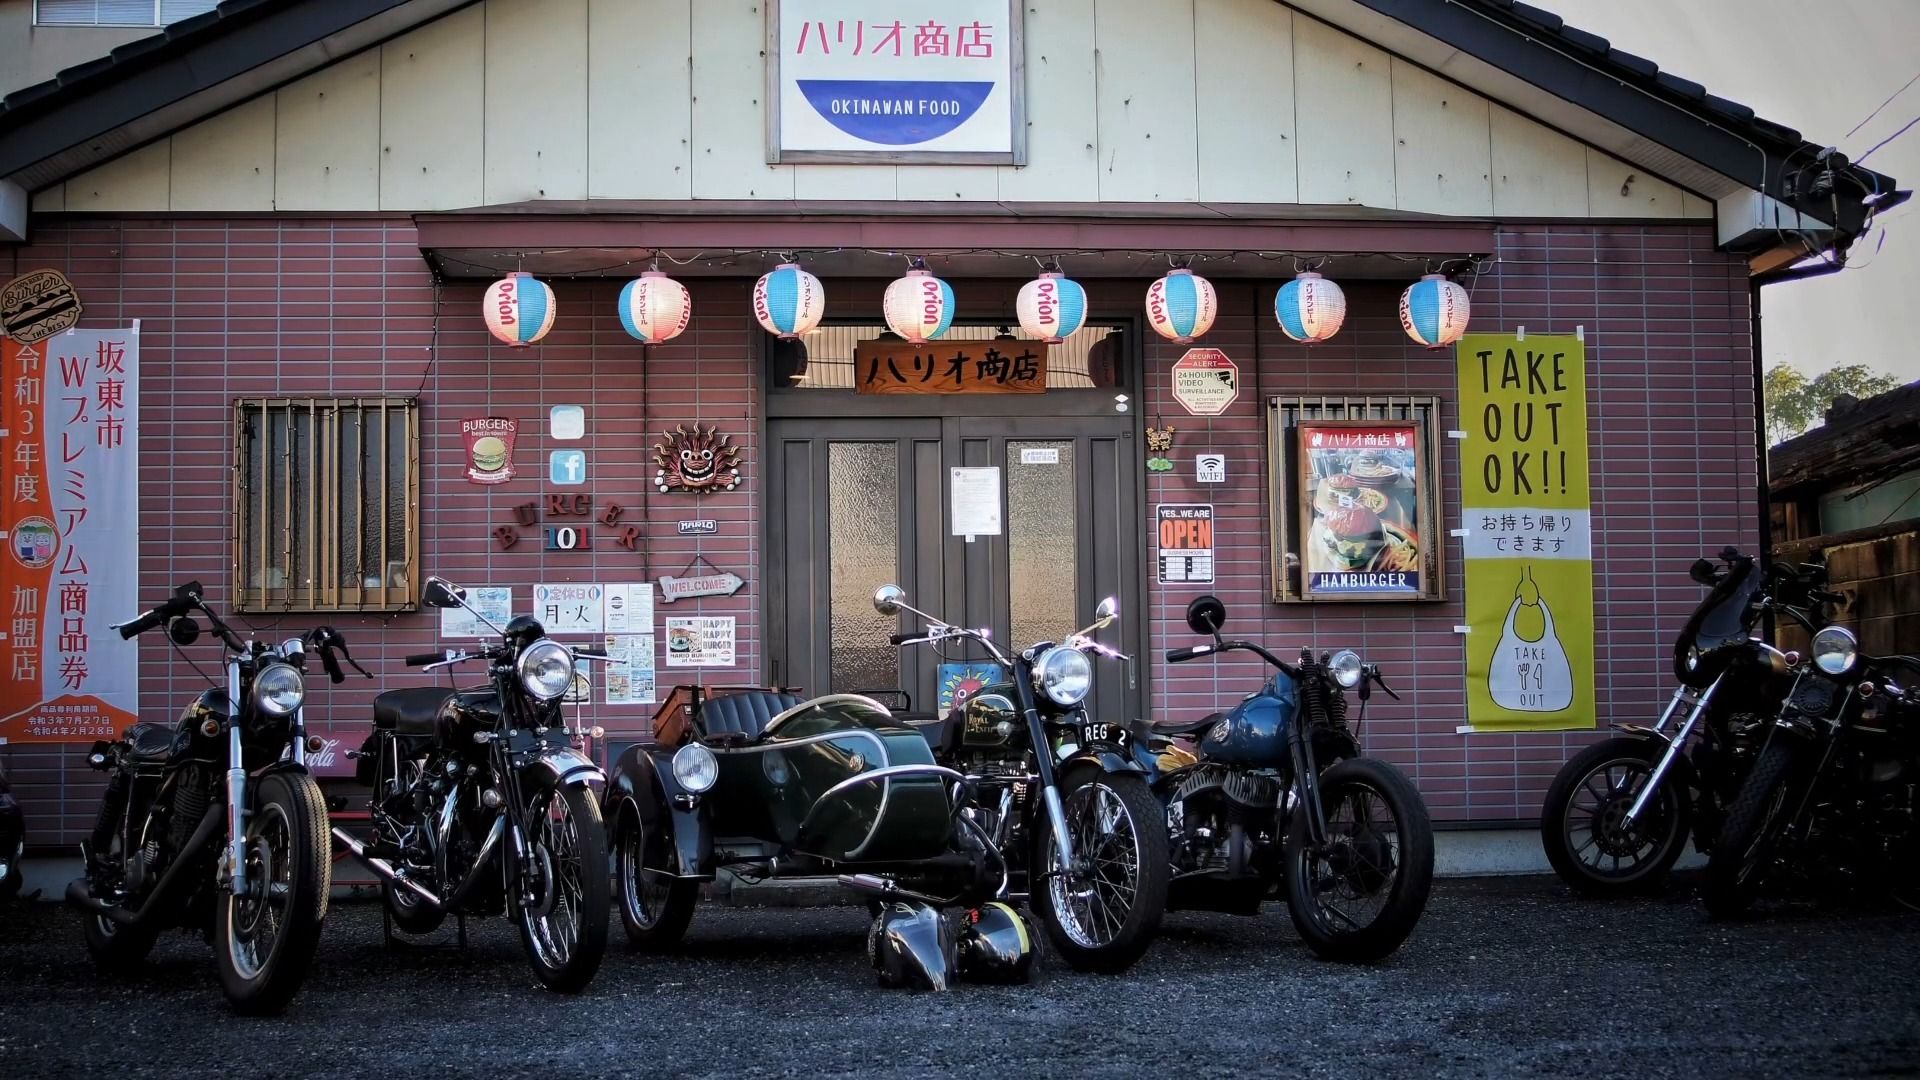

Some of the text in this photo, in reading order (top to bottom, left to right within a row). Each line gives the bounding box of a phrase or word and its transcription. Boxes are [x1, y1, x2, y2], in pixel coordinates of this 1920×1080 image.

[796, 20, 993, 57] ハリオ商店
[831, 99, 960, 116] OKINAWAN FOOD
[5, 276, 60, 309] Burger
[866, 348, 1039, 384] ハリオ商店
[1476, 348, 1567, 395] TAKE
[1177, 371, 1213, 379] 24 HOUR
[96, 340, 126, 449] 坂東市
[463, 419, 515, 433] BURGERS
[1483, 402, 1562, 445] OUT
[1328, 434, 1390, 446] ハリオ商店
[1483, 451, 1566, 495] OK!!
[58, 356, 90, 691] Wプレミアム商品券
[493, 494, 641, 550] BURGER
[681, 521, 714, 530] MARIO
[1482, 514, 1571, 532] お持ち帰り
[545, 527, 591, 549] 101
[1160, 520, 1211, 549] OPEN
[1492, 535, 1565, 552] できます
[669, 578, 727, 593] WELCOME
[1321, 573, 1406, 588] HAMBURGER
[551, 587, 586, 600] 定休日
[703, 620, 731, 628] HAPPY
[11, 585, 38, 681] 加盟店
[703, 631, 731, 639] HAPPY
[703, 641, 731, 649] BURGER
[1514, 647, 1546, 660] TAKE
[1520, 694, 1544, 706] OUT
[1085, 724, 1127, 746] REG 2
